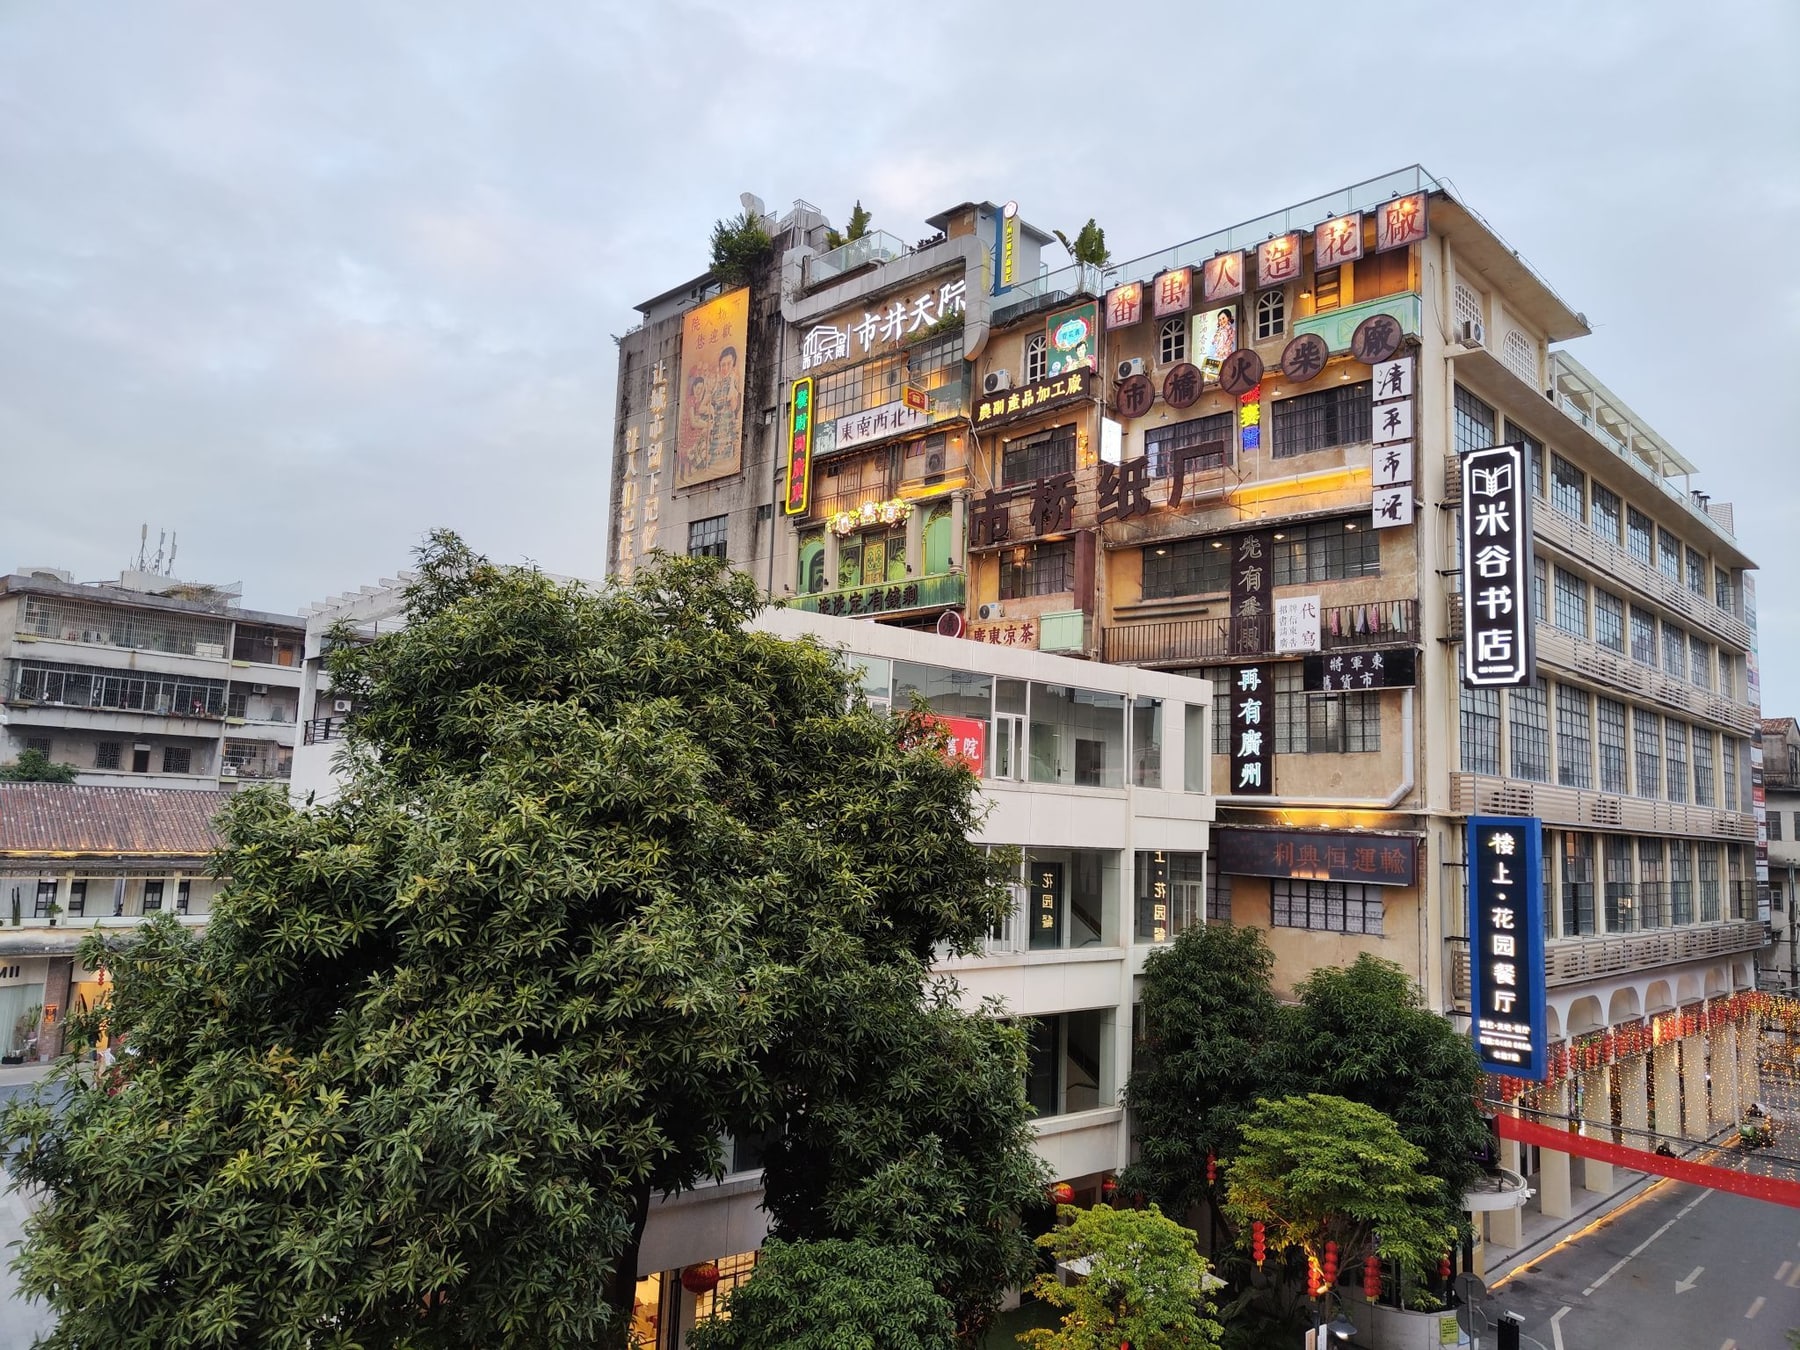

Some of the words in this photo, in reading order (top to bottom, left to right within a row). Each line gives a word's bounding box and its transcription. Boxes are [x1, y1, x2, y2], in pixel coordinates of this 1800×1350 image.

[853, 279, 966, 352] 市井天际
[1112, 197, 1424, 323] 番禺人造花廠
[1123, 319, 1394, 413] 市橋火柴廠
[969, 439, 1225, 546] 市桥纸厂
[1475, 501, 1514, 662] 米谷书店
[1237, 667, 1263, 789] 再有廣州
